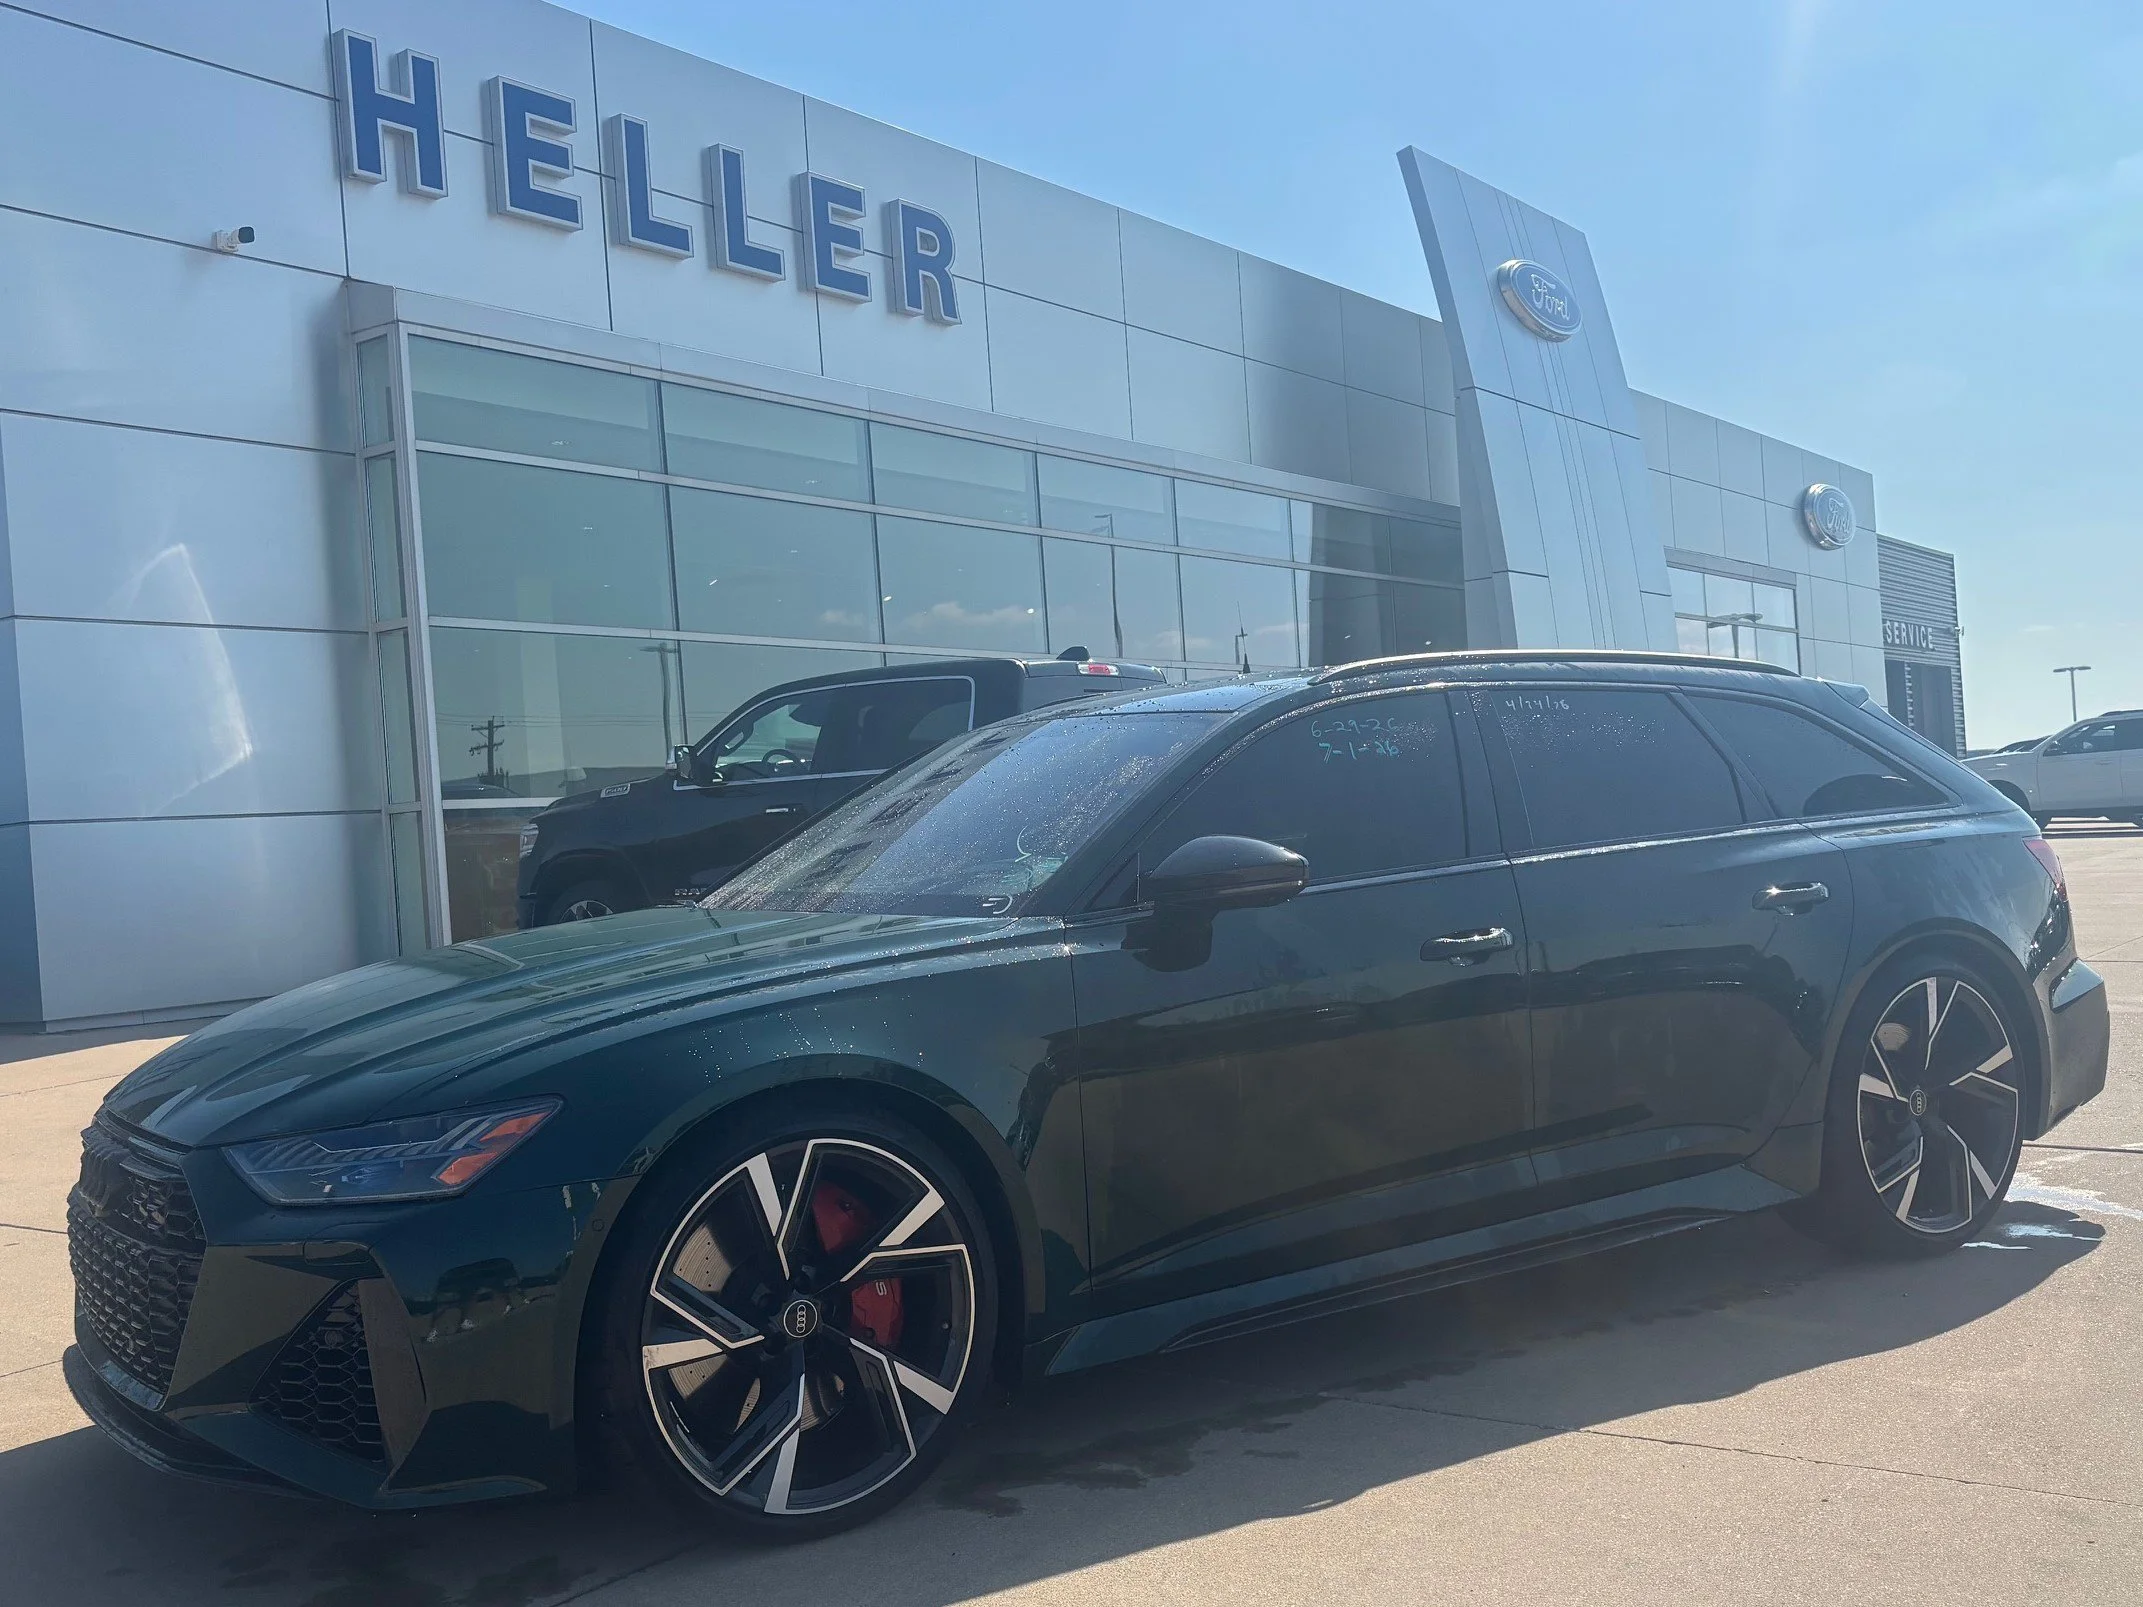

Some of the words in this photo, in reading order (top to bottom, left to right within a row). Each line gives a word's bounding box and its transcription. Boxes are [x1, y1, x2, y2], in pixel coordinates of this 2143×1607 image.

[334, 28, 962, 325] HELLER
[1530, 273, 1570, 321] Ford
[1827, 497, 1850, 534] Ford
[1886, 620, 1934, 649] SERVICE
[1311, 717, 1401, 738] 6-29-26
[1318, 740, 1400, 764] 7-1-26
